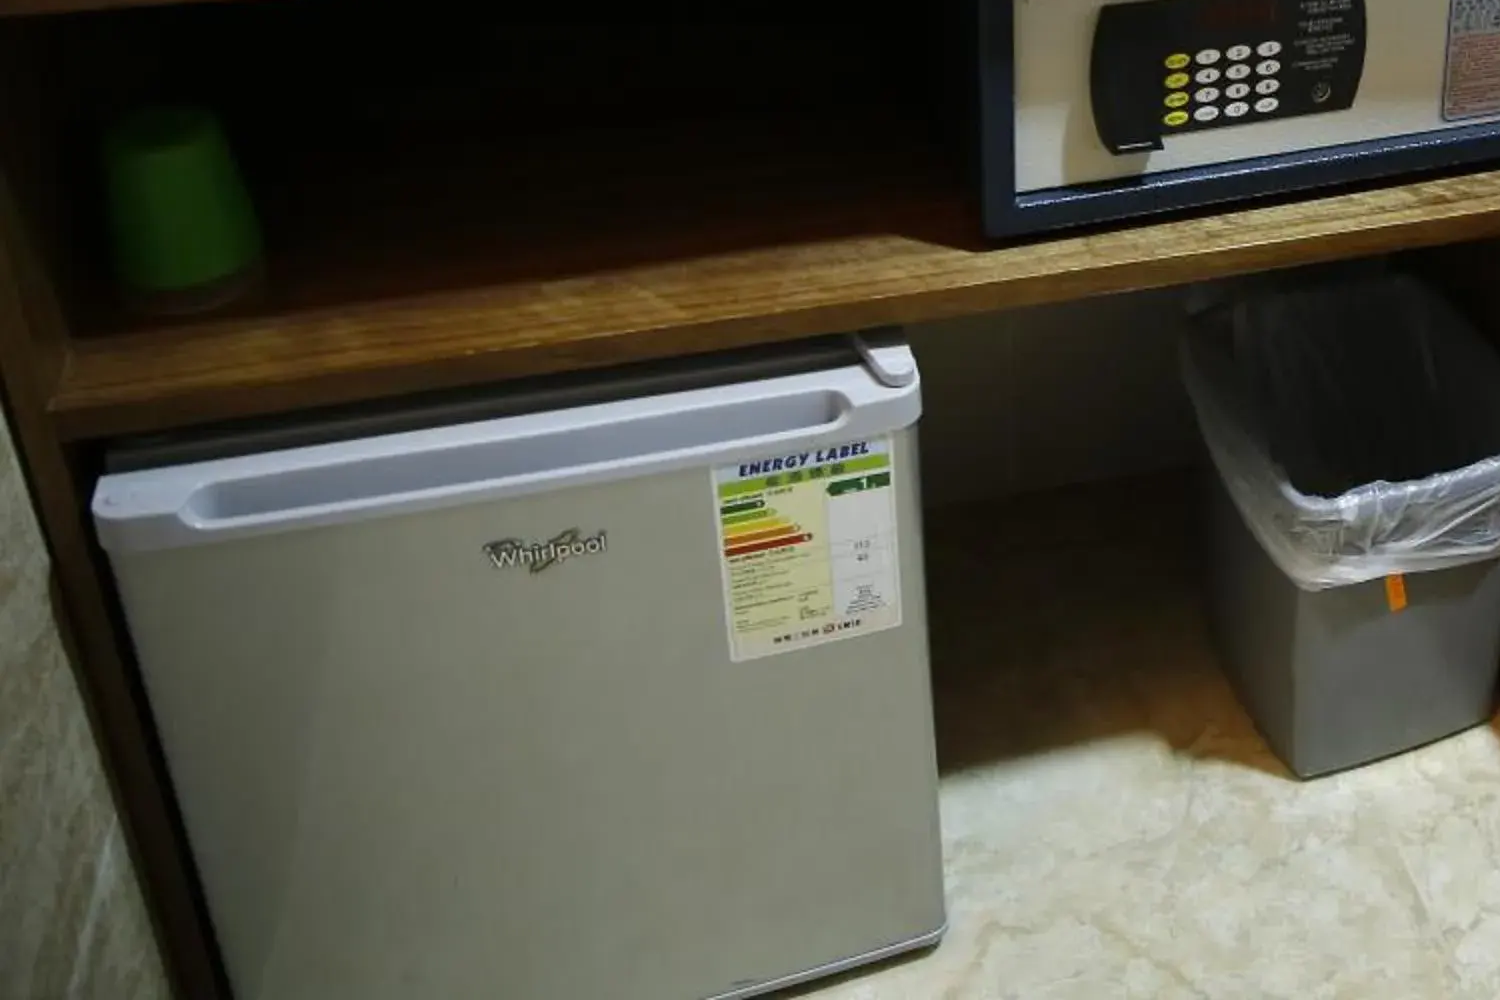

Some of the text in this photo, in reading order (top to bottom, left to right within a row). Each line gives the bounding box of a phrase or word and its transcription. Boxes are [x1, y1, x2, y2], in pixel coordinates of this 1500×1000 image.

[739, 452, 809, 477] ENERGY
[815, 441, 869, 463] LABEL
[489, 532, 606, 569] Whirlpool
